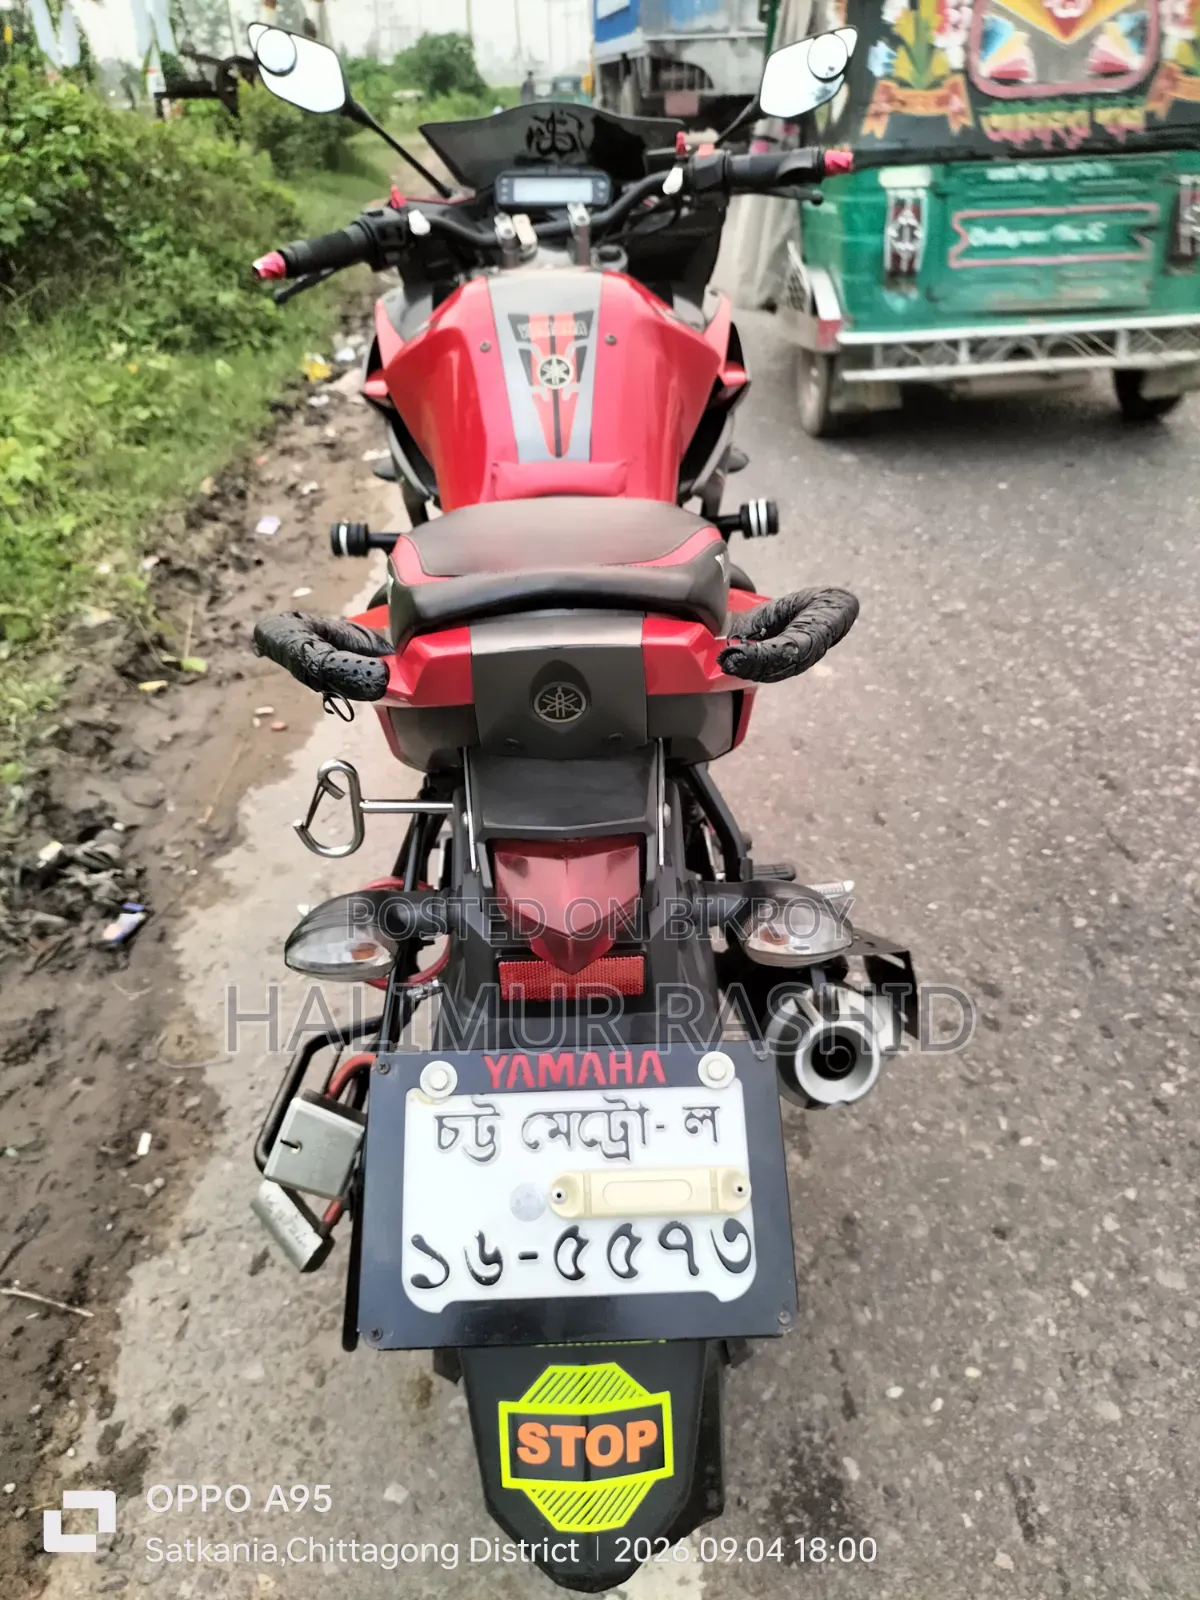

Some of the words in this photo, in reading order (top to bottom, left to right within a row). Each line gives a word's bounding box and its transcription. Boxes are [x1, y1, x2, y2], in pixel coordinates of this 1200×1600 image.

[482, 1050, 667, 1089] YAMAHA
[433, 1097, 502, 1164] চট্ট
[410, 1217, 752, 1290] ১৬-৫৫৭৩
[516, 1419, 658, 1467] STOP
